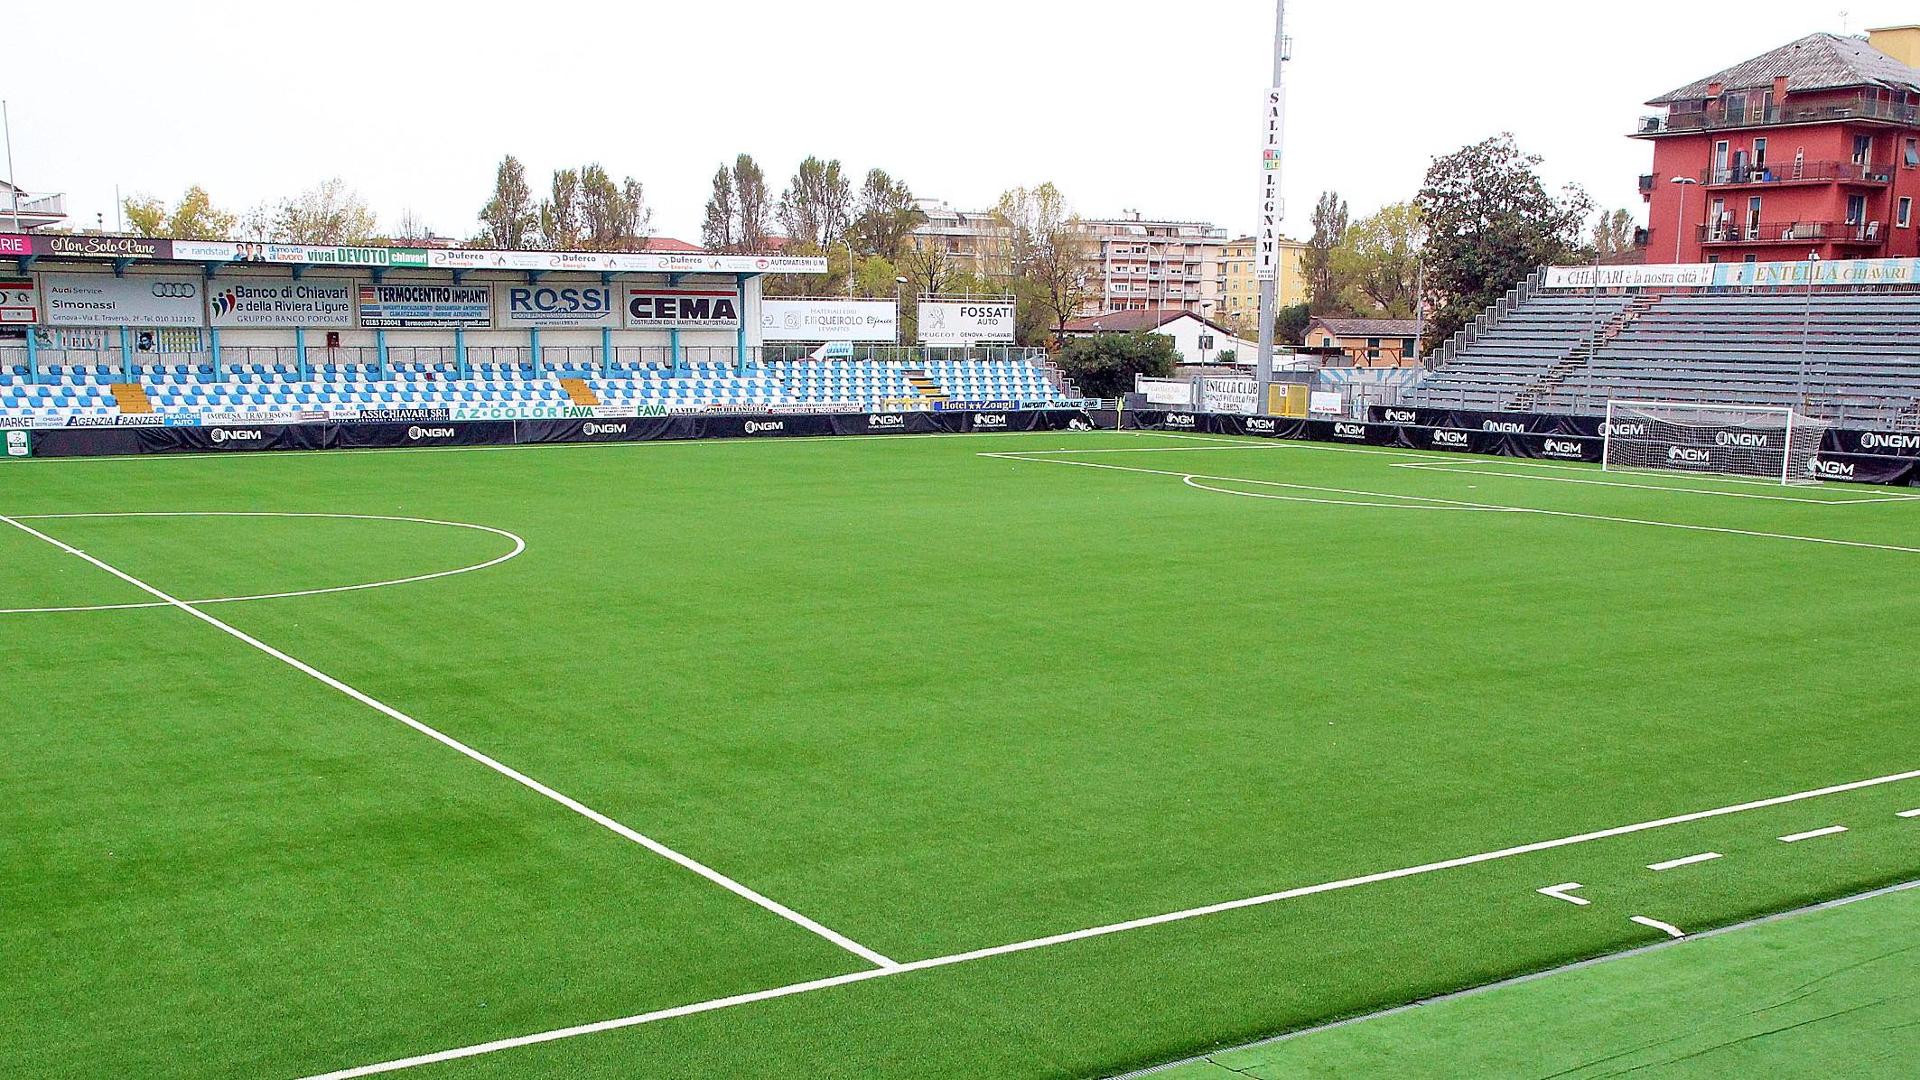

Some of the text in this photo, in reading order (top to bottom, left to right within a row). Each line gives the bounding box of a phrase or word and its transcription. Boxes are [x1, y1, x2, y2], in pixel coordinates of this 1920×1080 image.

[1262, 174, 1276, 266] LEGNAMI
[0, 238, 24, 251] RIE
[51, 237, 156, 254] Non Solo Pane
[307, 248, 427, 264] vivai DEVOTO chiavari
[1567, 270, 1626, 284] CHIAVARI
[1645, 271, 1674, 283] nostra
[1756, 265, 1907, 281] ENTELLA CHIAVARI
[236, 286, 348, 299] Banco di Chiavari
[377, 286, 488, 303] TERMOCENTRO IMPIANTI
[52, 299, 116, 309] Simonassi
[511, 288, 610, 311] ROSSI
[236, 301, 349, 314] e della Riviera Ligure
[630, 297, 738, 319] CEMA
[960, 307, 1013, 318] FOSSATI
[818, 315, 863, 325] QUEIROLO
[638, 405, 667, 416] FAVA
[941, 400, 967, 410] Hotel
[207, 412, 241, 420] IMPRESA
[361, 409, 448, 419] ASSICHIAVARI SRL
[563, 406, 594, 417] FAVA
[1393, 410, 1416, 422] NGM
[65, 415, 163, 427] AGENZIA FRANZESE
[875, 415, 903, 425] NGM
[979, 414, 1006, 424] NGM
[1172, 414, 1194, 424] NGM
[1251, 419, 1275, 429] NGM
[594, 424, 626, 433] NGM
[754, 421, 783, 430] NGM
[1339, 424, 1365, 435] NGM
[1493, 422, 1524, 433] NGM
[1608, 423, 1644, 435] NGM
[224, 431, 261, 440] NGM
[420, 428, 454, 437] NGM
[1440, 432, 1467, 443] NGM
[1727, 434, 1767, 447] NGM
[1874, 435, 1920, 448] NGM
[1550, 441, 1582, 453] NGM
[1674, 449, 1710, 461] NGM
[1815, 461, 1855, 475] NGM
